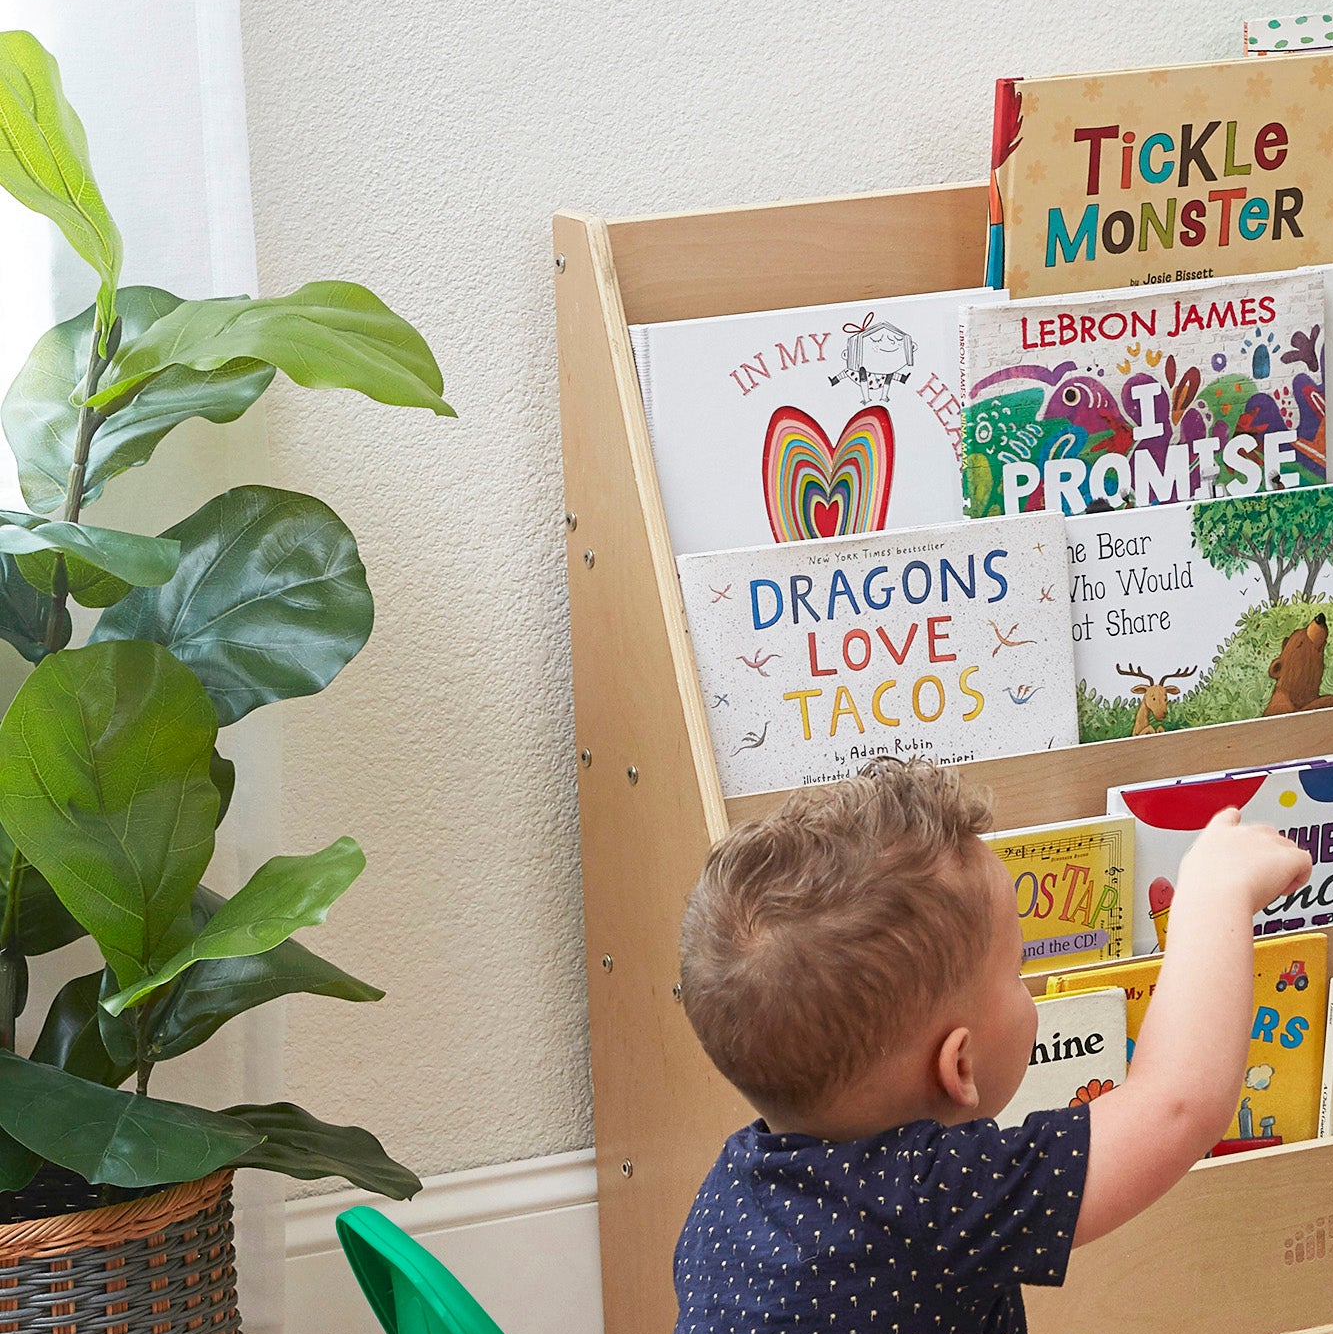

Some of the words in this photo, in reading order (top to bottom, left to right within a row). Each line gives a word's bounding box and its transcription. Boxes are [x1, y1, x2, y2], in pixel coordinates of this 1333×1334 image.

[1142, 271, 1172, 285] Josie
[1175, 268, 1214, 283] Bissett
[1021, 308, 1157, 350] LEBRON
[1167, 296, 1277, 337] JAMES
[729, 352, 771, 396] IN
[775, 332, 832, 371] MY
[1130, 382, 1165, 441] I
[1001, 430, 1300, 515] PROMISE
[896, 542, 945, 555] bestseller
[1096, 532, 1152, 560] Bear
[749, 549, 1008, 631] DRAGONS
[1116, 562, 1193, 595] Would
[1072, 613, 1094, 642] ot
[1106, 608, 1171, 637] Share
[808, 615, 957, 677] LOVE
[783, 666, 985, 741] TACOS
[835, 752, 845, 765] by
[850, 745, 889, 760] Adam
[895, 738, 933, 755] Rubin
[803, 771, 849, 785] illustrated
[1049, 939, 1070, 953] the
[1074, 933, 1097, 948] CD!
[1125, 987, 1144, 1000] My
[1028, 1032, 1104, 1066] hine
